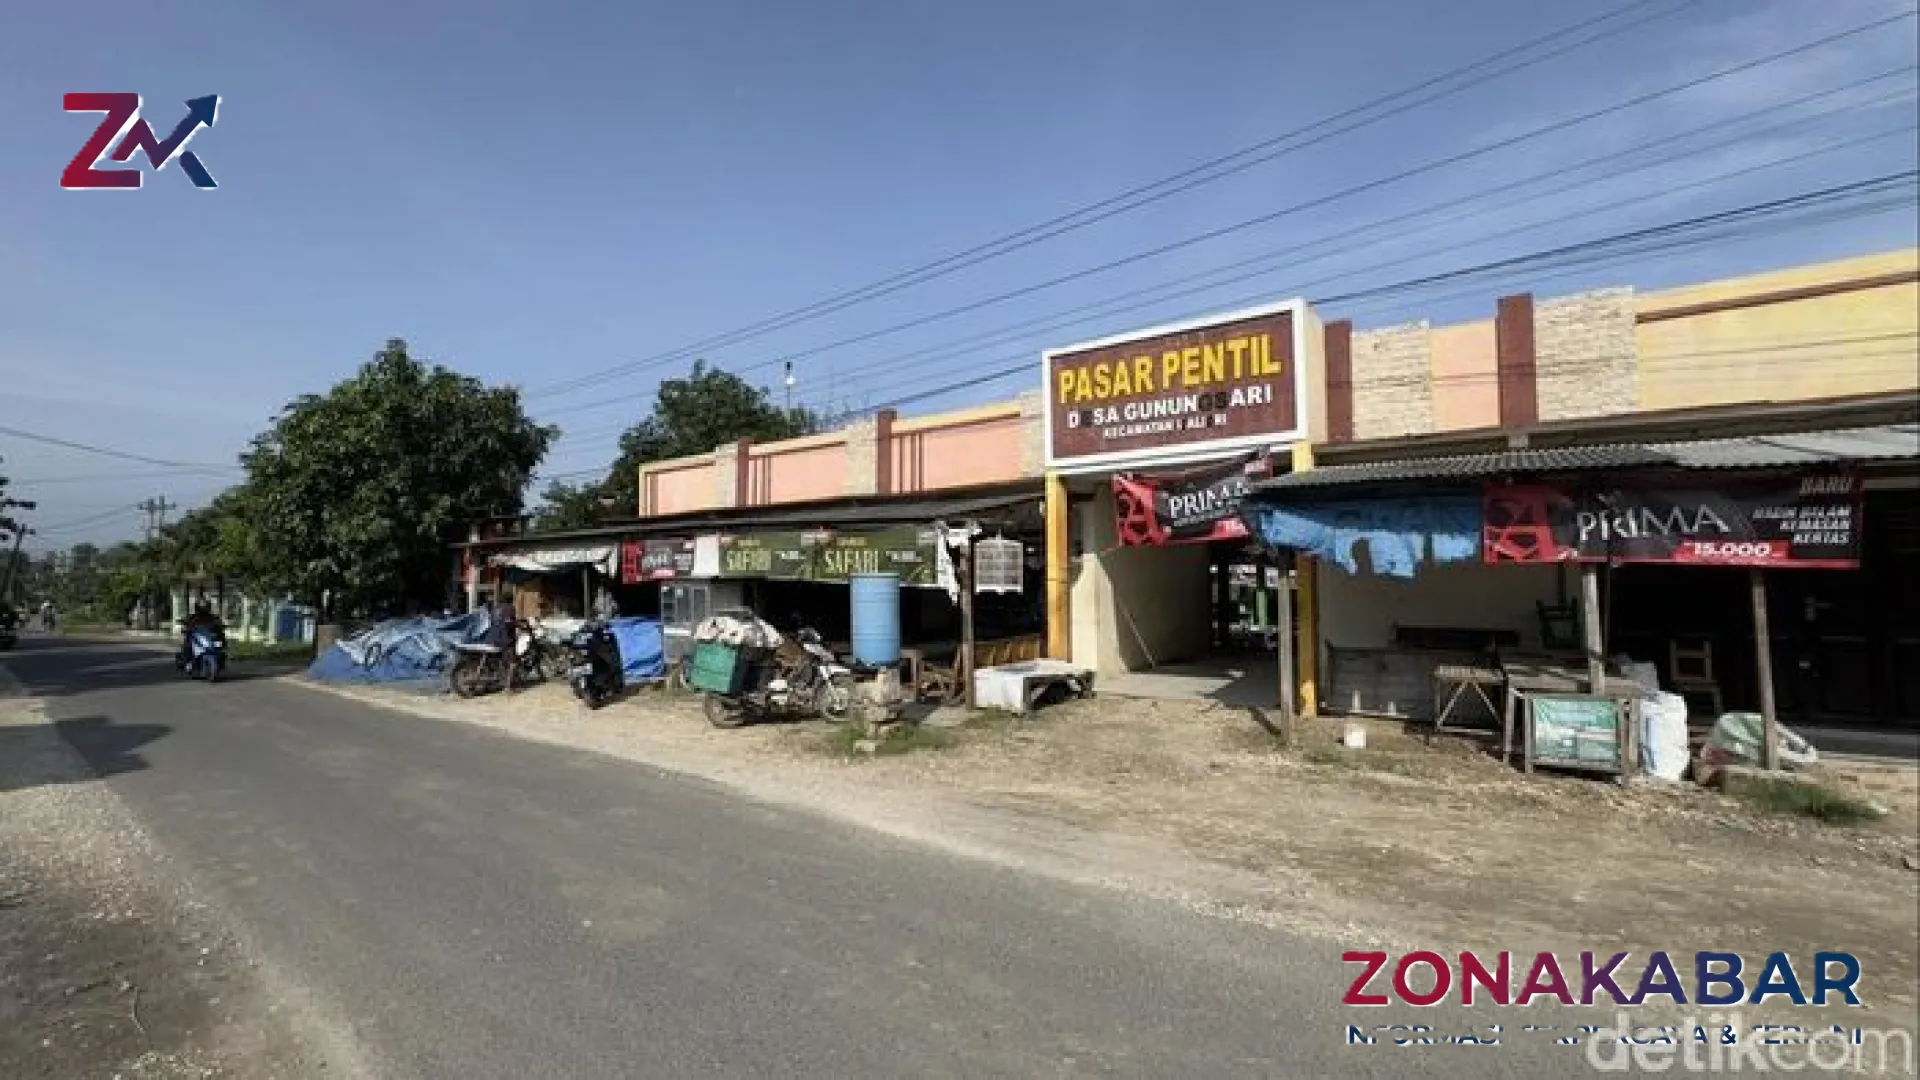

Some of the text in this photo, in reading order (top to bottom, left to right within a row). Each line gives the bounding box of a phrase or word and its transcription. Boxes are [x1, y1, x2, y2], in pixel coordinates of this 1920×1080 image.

[1059, 332, 1283, 404] PASAR PENTIL
[1577, 503, 1731, 541] PRIMA
